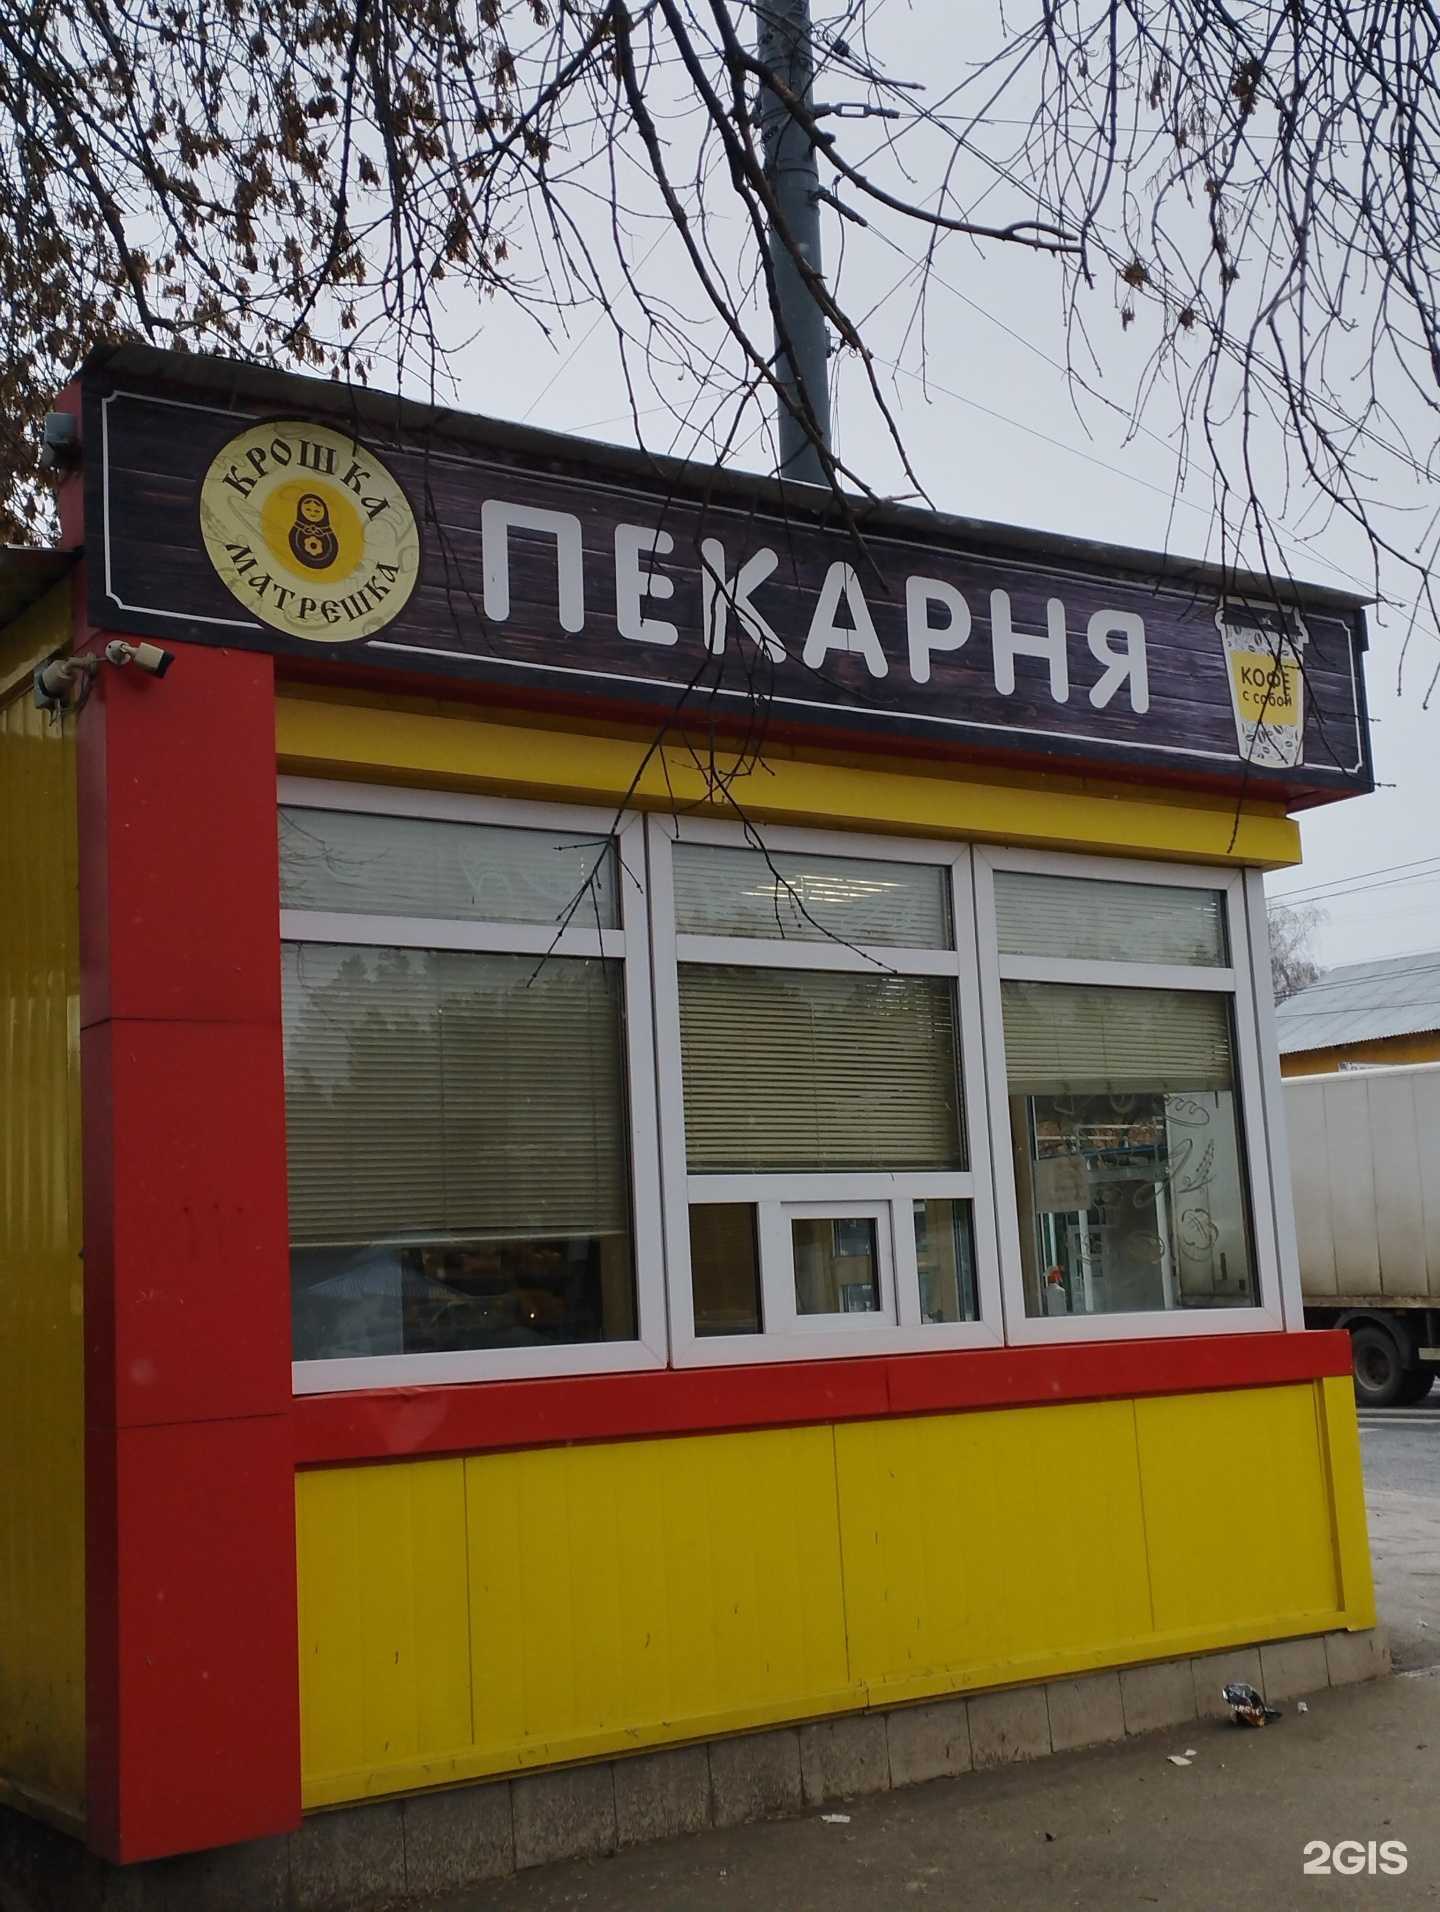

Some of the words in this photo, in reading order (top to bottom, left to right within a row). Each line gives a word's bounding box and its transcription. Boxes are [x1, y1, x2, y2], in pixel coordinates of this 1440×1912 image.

[222, 438, 391, 521] КРОШКА
[481, 499, 1150, 714] ПЕКАРНЯ
[1241, 666, 1291, 691] КОФЕ
